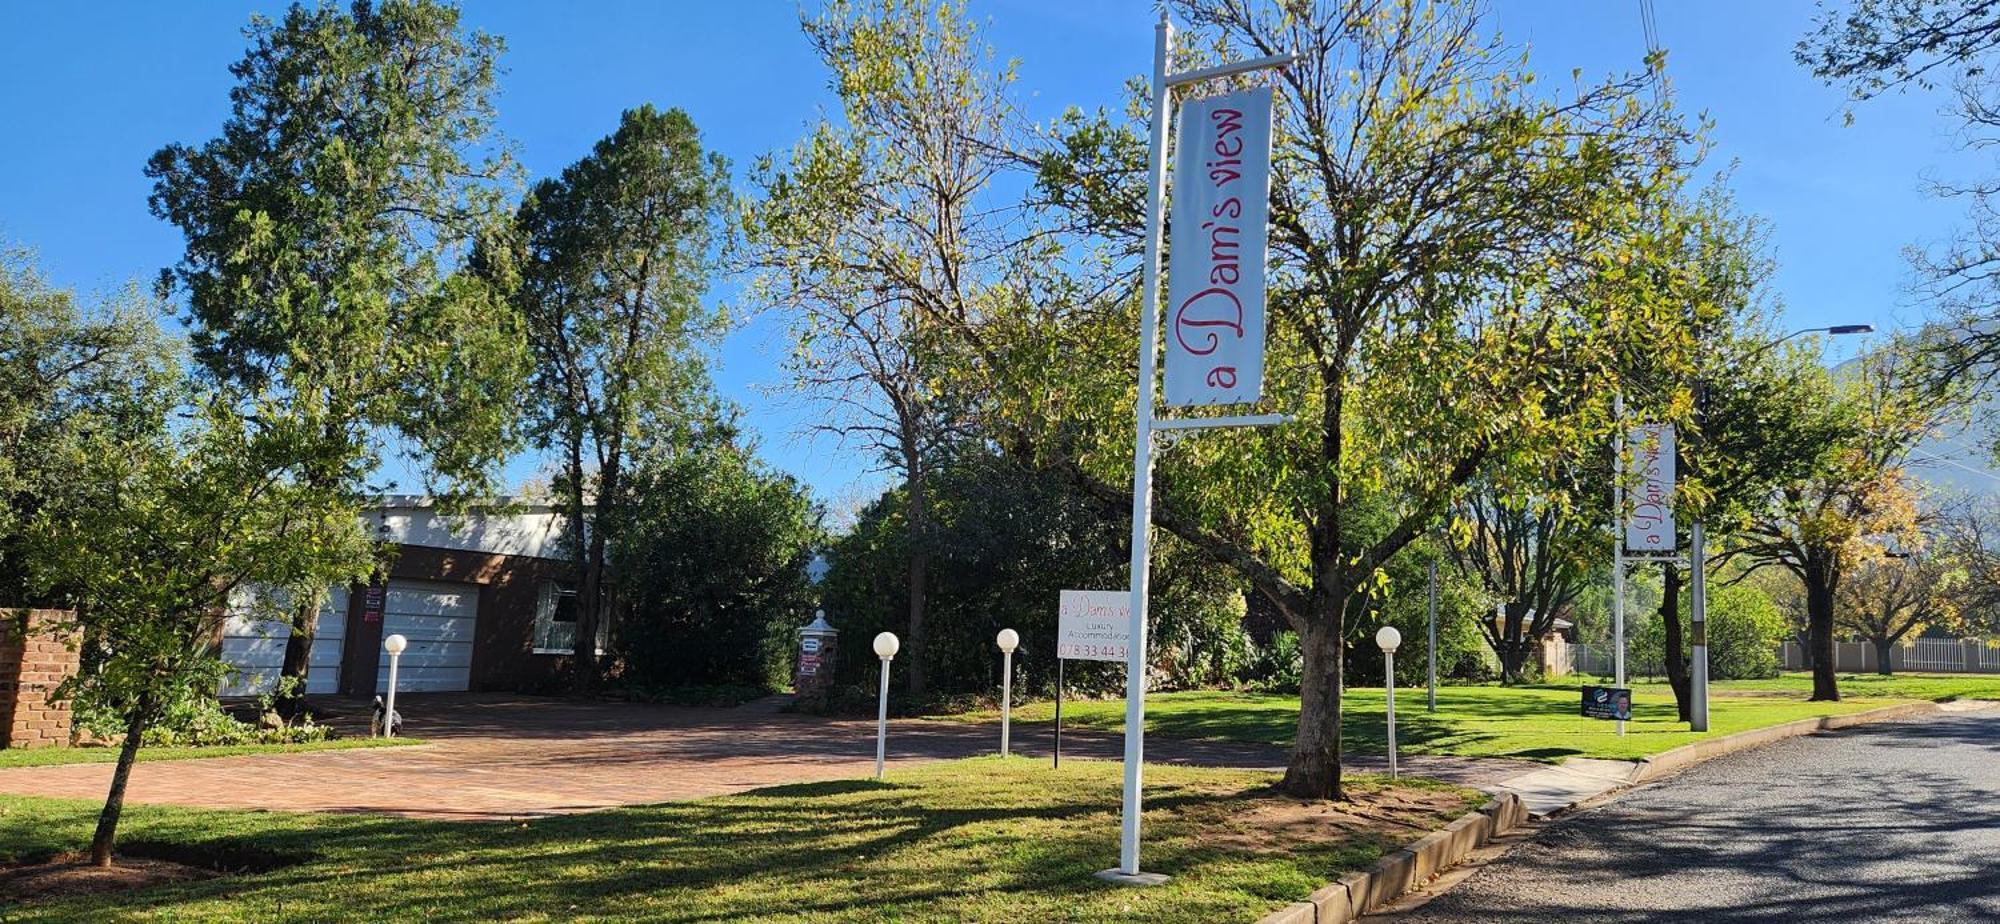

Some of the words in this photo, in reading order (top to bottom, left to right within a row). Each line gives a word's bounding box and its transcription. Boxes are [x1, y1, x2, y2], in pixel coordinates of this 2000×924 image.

[1206, 108, 1244, 188] view
[1174, 196, 1244, 356] Dam's
[1206, 366, 1238, 389] a
[1632, 467, 1663, 530] Dams
[1646, 534, 1661, 545] a
[1059, 644, 1081, 656] 078
[1083, 645, 1098, 657] 33
[1101, 646, 1115, 657] 44
